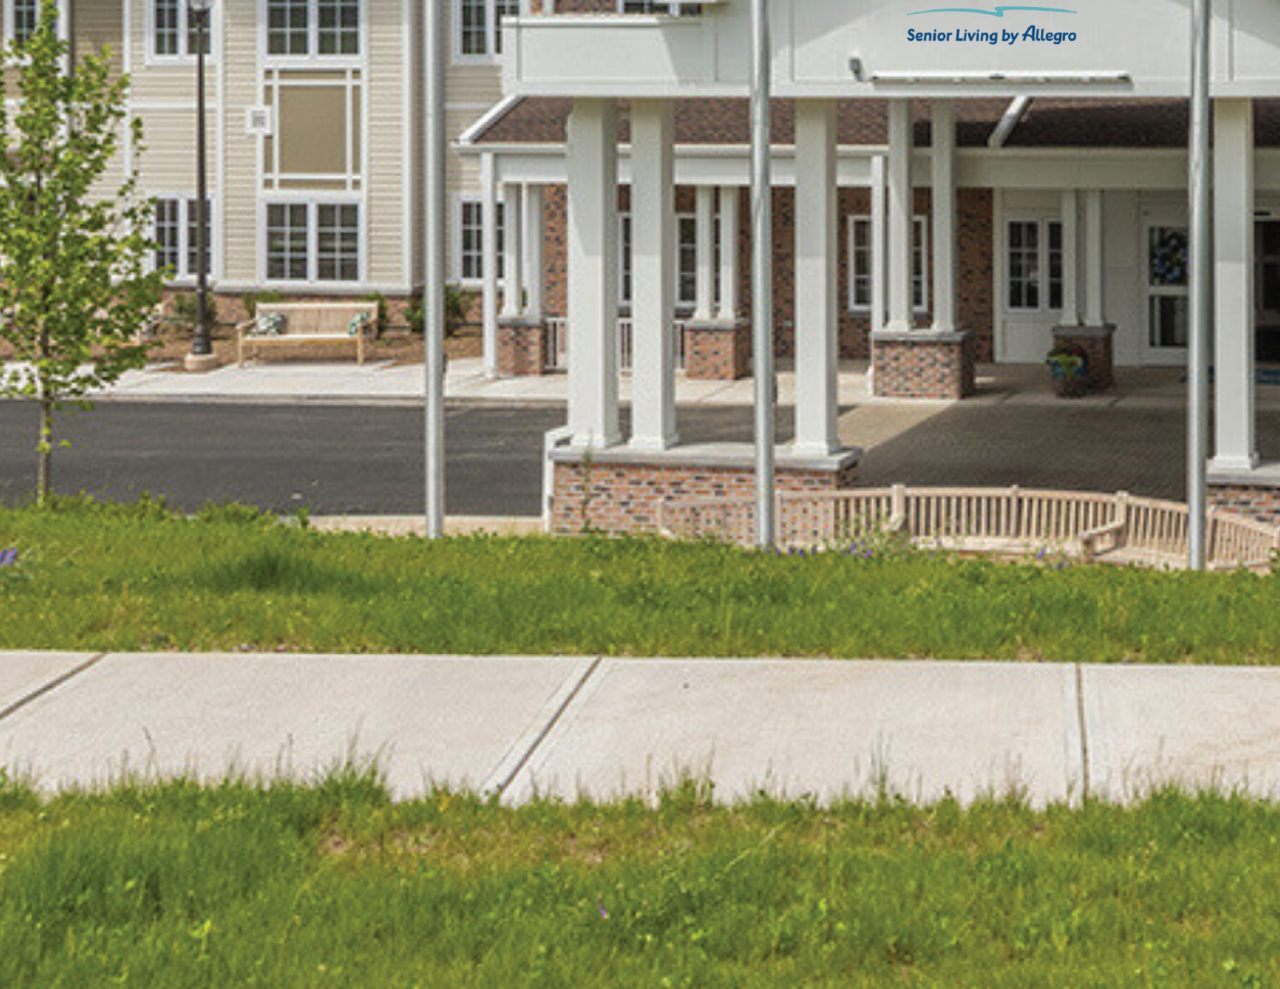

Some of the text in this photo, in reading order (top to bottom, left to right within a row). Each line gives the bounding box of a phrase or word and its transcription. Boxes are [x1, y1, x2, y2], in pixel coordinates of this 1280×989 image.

[906, 24, 1077, 45] Senior Living by Allegro
